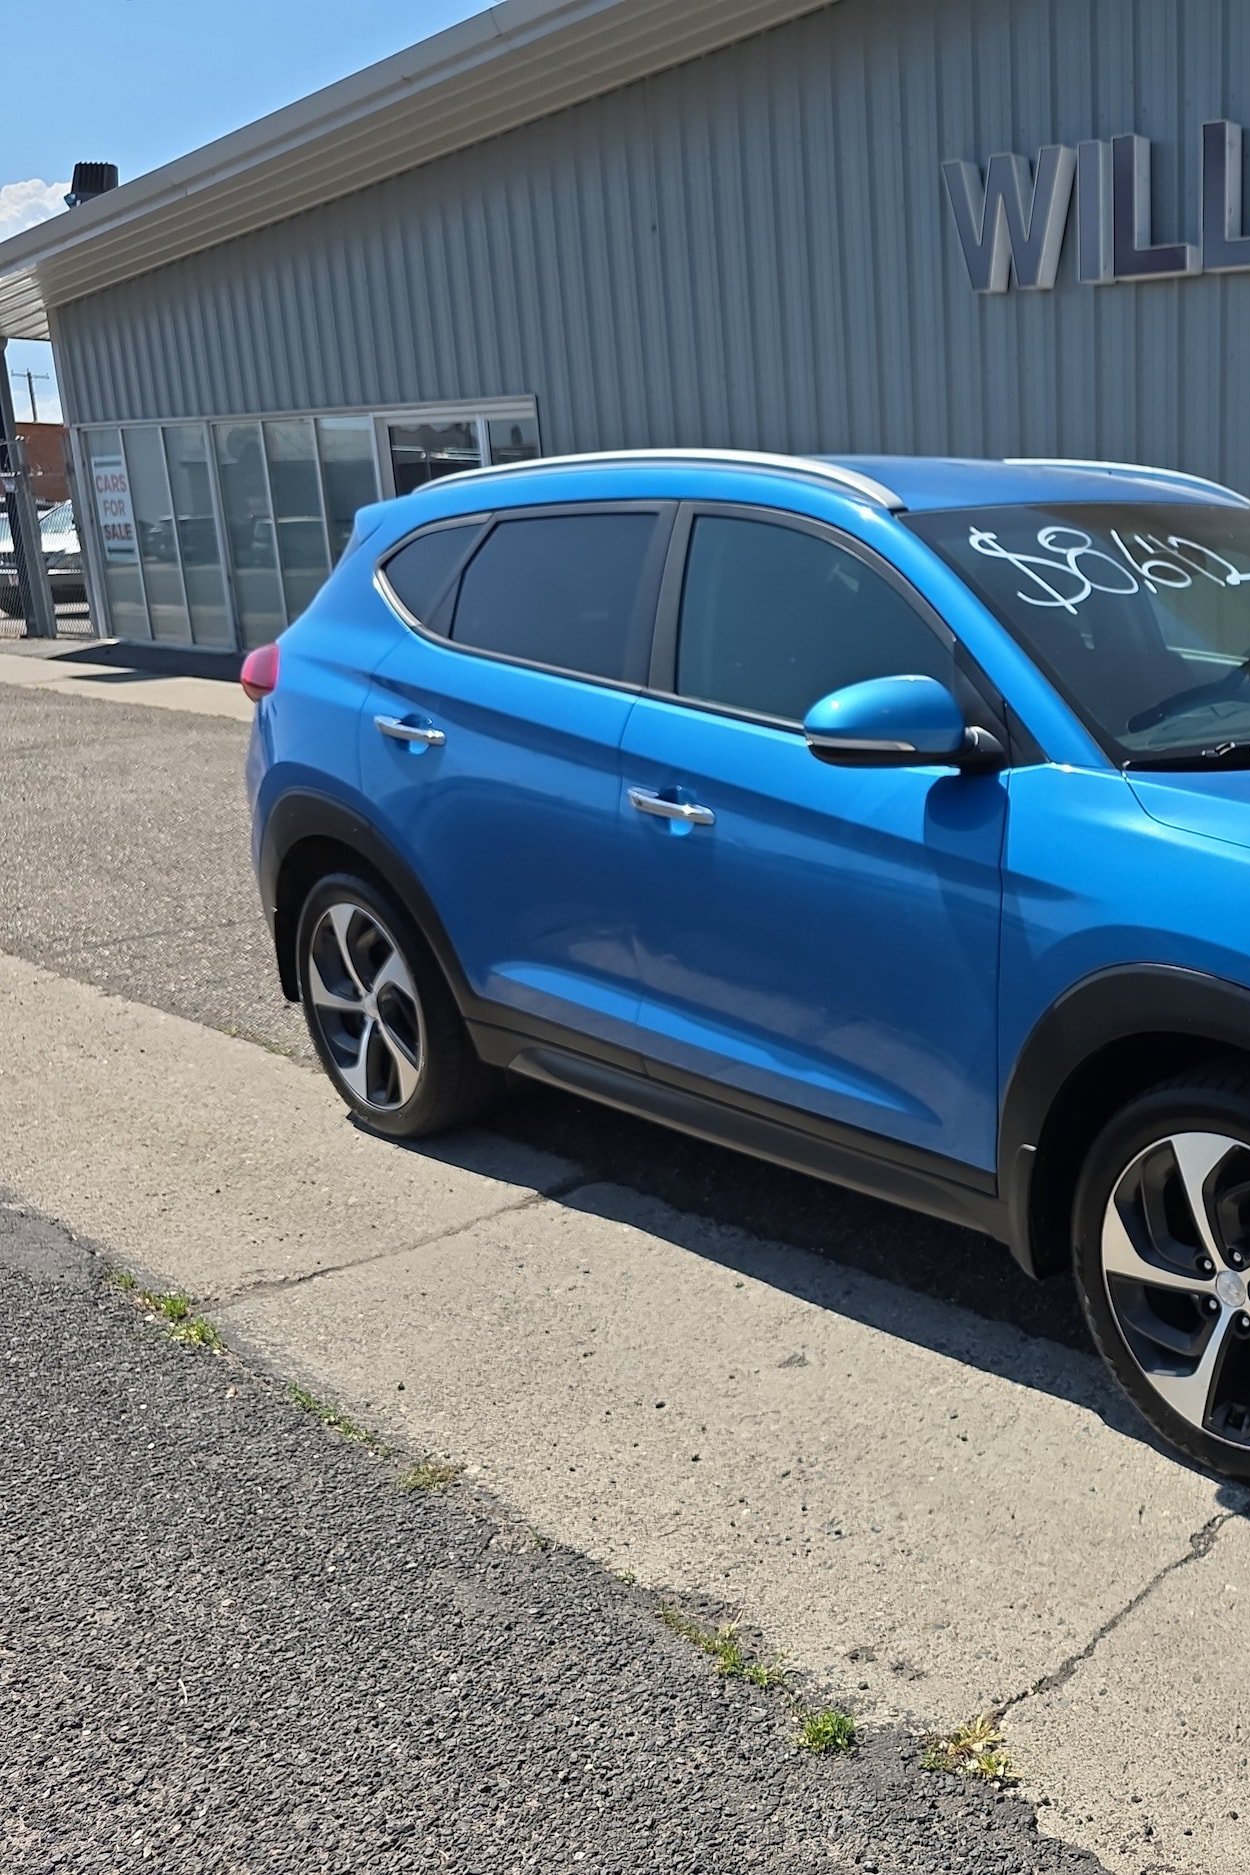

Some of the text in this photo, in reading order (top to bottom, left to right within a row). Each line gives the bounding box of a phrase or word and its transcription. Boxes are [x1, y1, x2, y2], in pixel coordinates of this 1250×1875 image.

[95, 474, 127, 494] CARS
[103, 499, 126, 517] FOR
[104, 523, 134, 541] SALE
